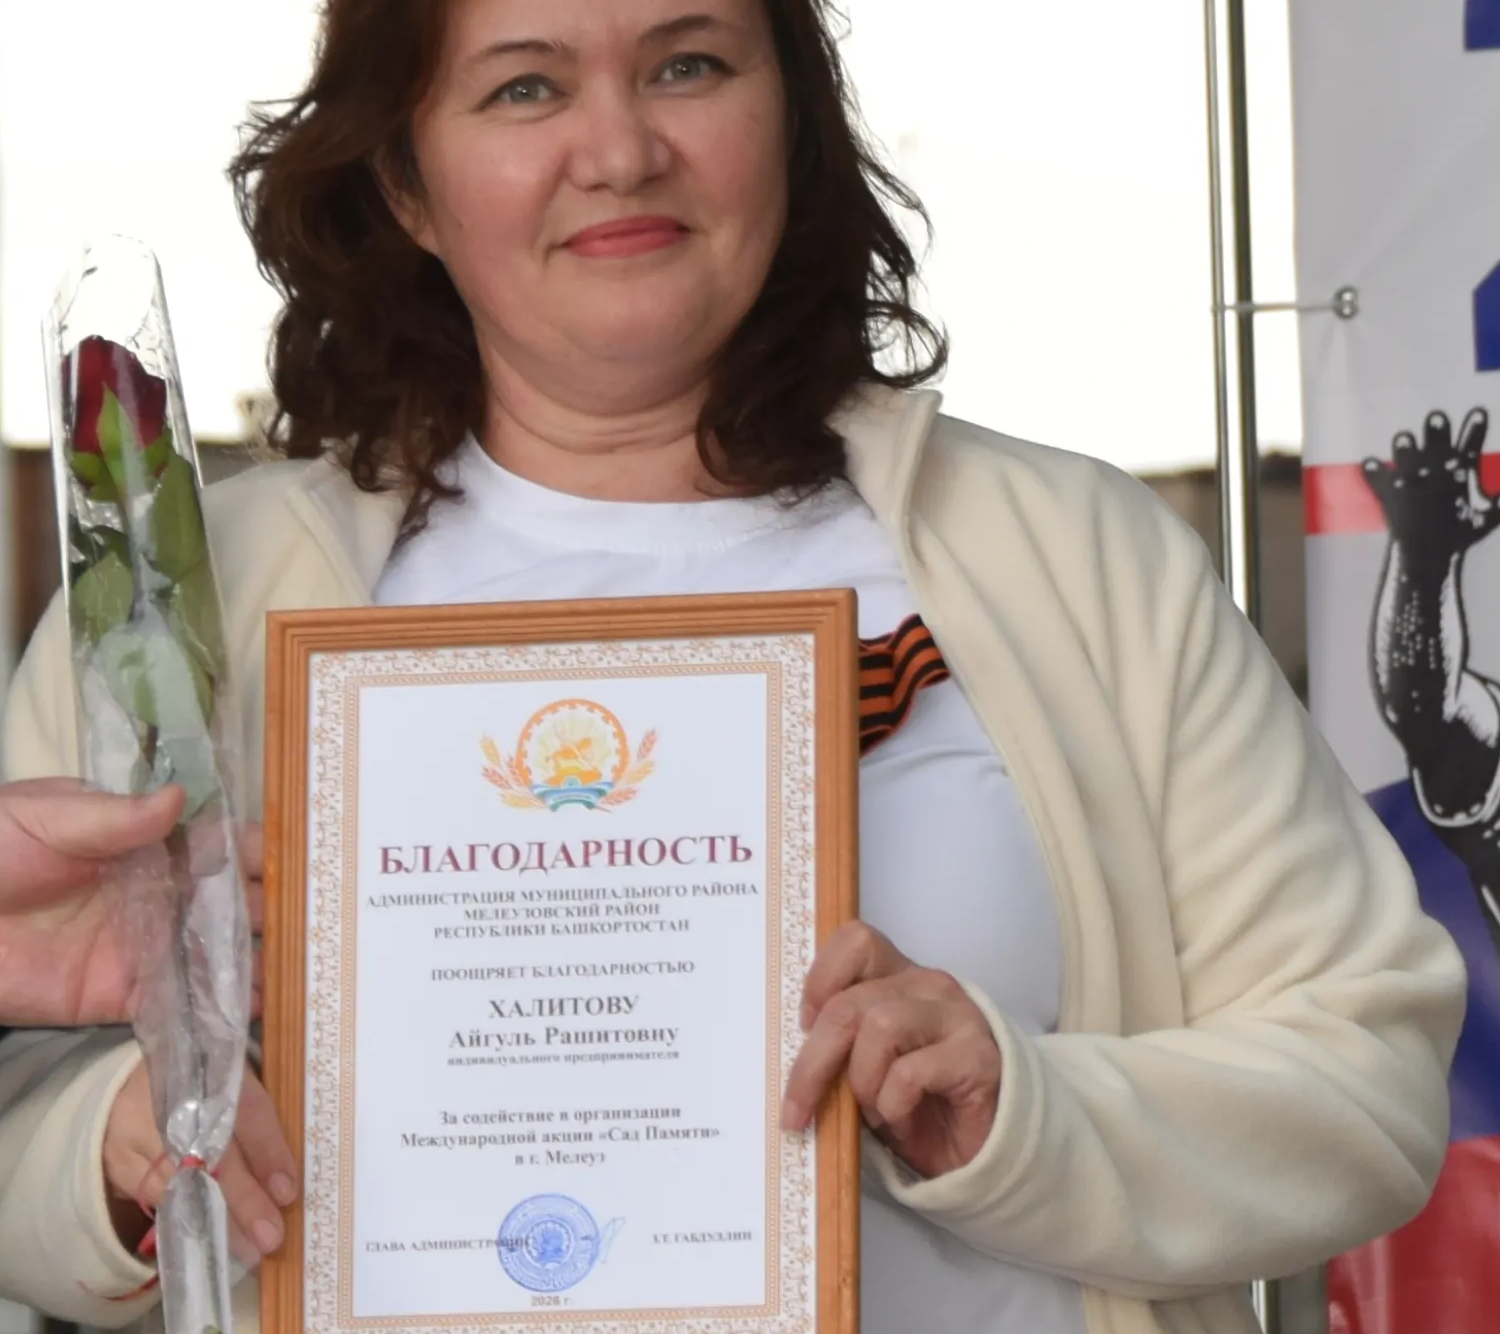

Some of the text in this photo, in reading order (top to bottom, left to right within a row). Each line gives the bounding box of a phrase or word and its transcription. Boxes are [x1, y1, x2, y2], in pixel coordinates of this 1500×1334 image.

[380, 834, 753, 875] БЛАГОДАРНОСТЬ
[366, 881, 759, 909] АДМИНИСТРАЦИЯ МУНИЦИПАЛЬНОГО РАЙОНА
[462, 901, 660, 921] МЕЛЕУЗОВСКИЙ РАЙОН
[434, 918, 690, 939] РЕСПУБЛИКИ БАШКОРТОСТАН
[431, 960, 696, 982] ПООЩРЯЕТ БЛАГОДАРНОСТЬЮ
[489, 995, 639, 1019] ХАЛИТОВУ
[449, 1026, 679, 1053] Айгуль Рашитовну
[439, 1110, 458, 1126] За
[462, 1109, 555, 1125] содействие
[573, 1107, 682, 1125] организации
[400, 1125, 720, 1151] Международной акции «Сад Памяти»
[514, 1154, 525, 1166] в
[545, 1149, 606, 1167] Мелеуз
[530, 1294, 562, 1308] 2026
